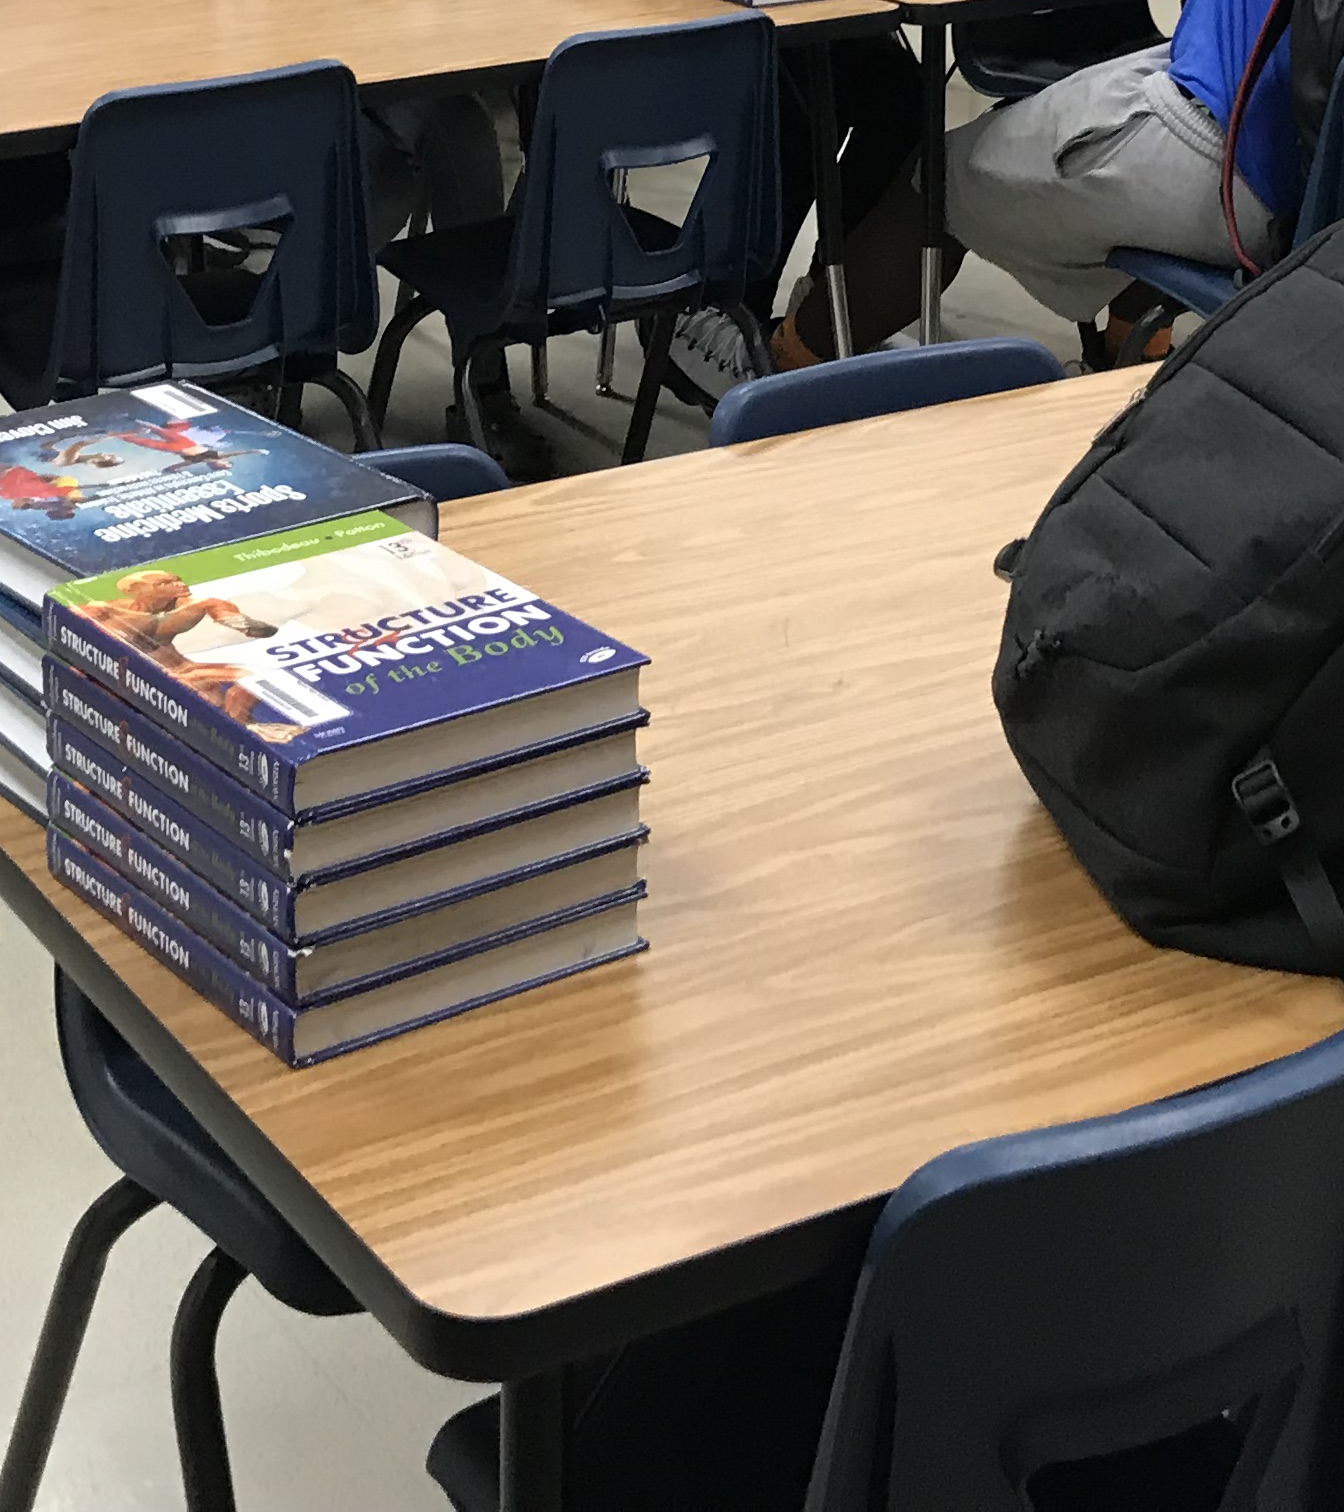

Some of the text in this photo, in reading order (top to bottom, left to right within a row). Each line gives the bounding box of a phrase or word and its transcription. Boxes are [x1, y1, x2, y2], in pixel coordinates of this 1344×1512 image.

[49, 414, 88, 434] Jim
[93, 501, 223, 545] Medicine
[102, 478, 246, 522] Essentials
[212, 483, 308, 517] Sports
[233, 519, 387, 564] Thibodeau Patton
[265, 587, 520, 663] STRUCTURE
[293, 601, 553, 684] FUNCTION
[344, 672, 381, 697] of
[388, 659, 444, 683] the
[443, 623, 565, 667] Body
[60, 625, 189, 728] STRUCTURE FUNCTION
[62, 687, 189, 793] STRUCTURE FUNCTION
[65, 742, 191, 852] STRUCTURE FUNCTION
[63, 798, 191, 911] STRUCTURE FUNCTION
[63, 857, 190, 970] STRUCTURE FUNCTION
